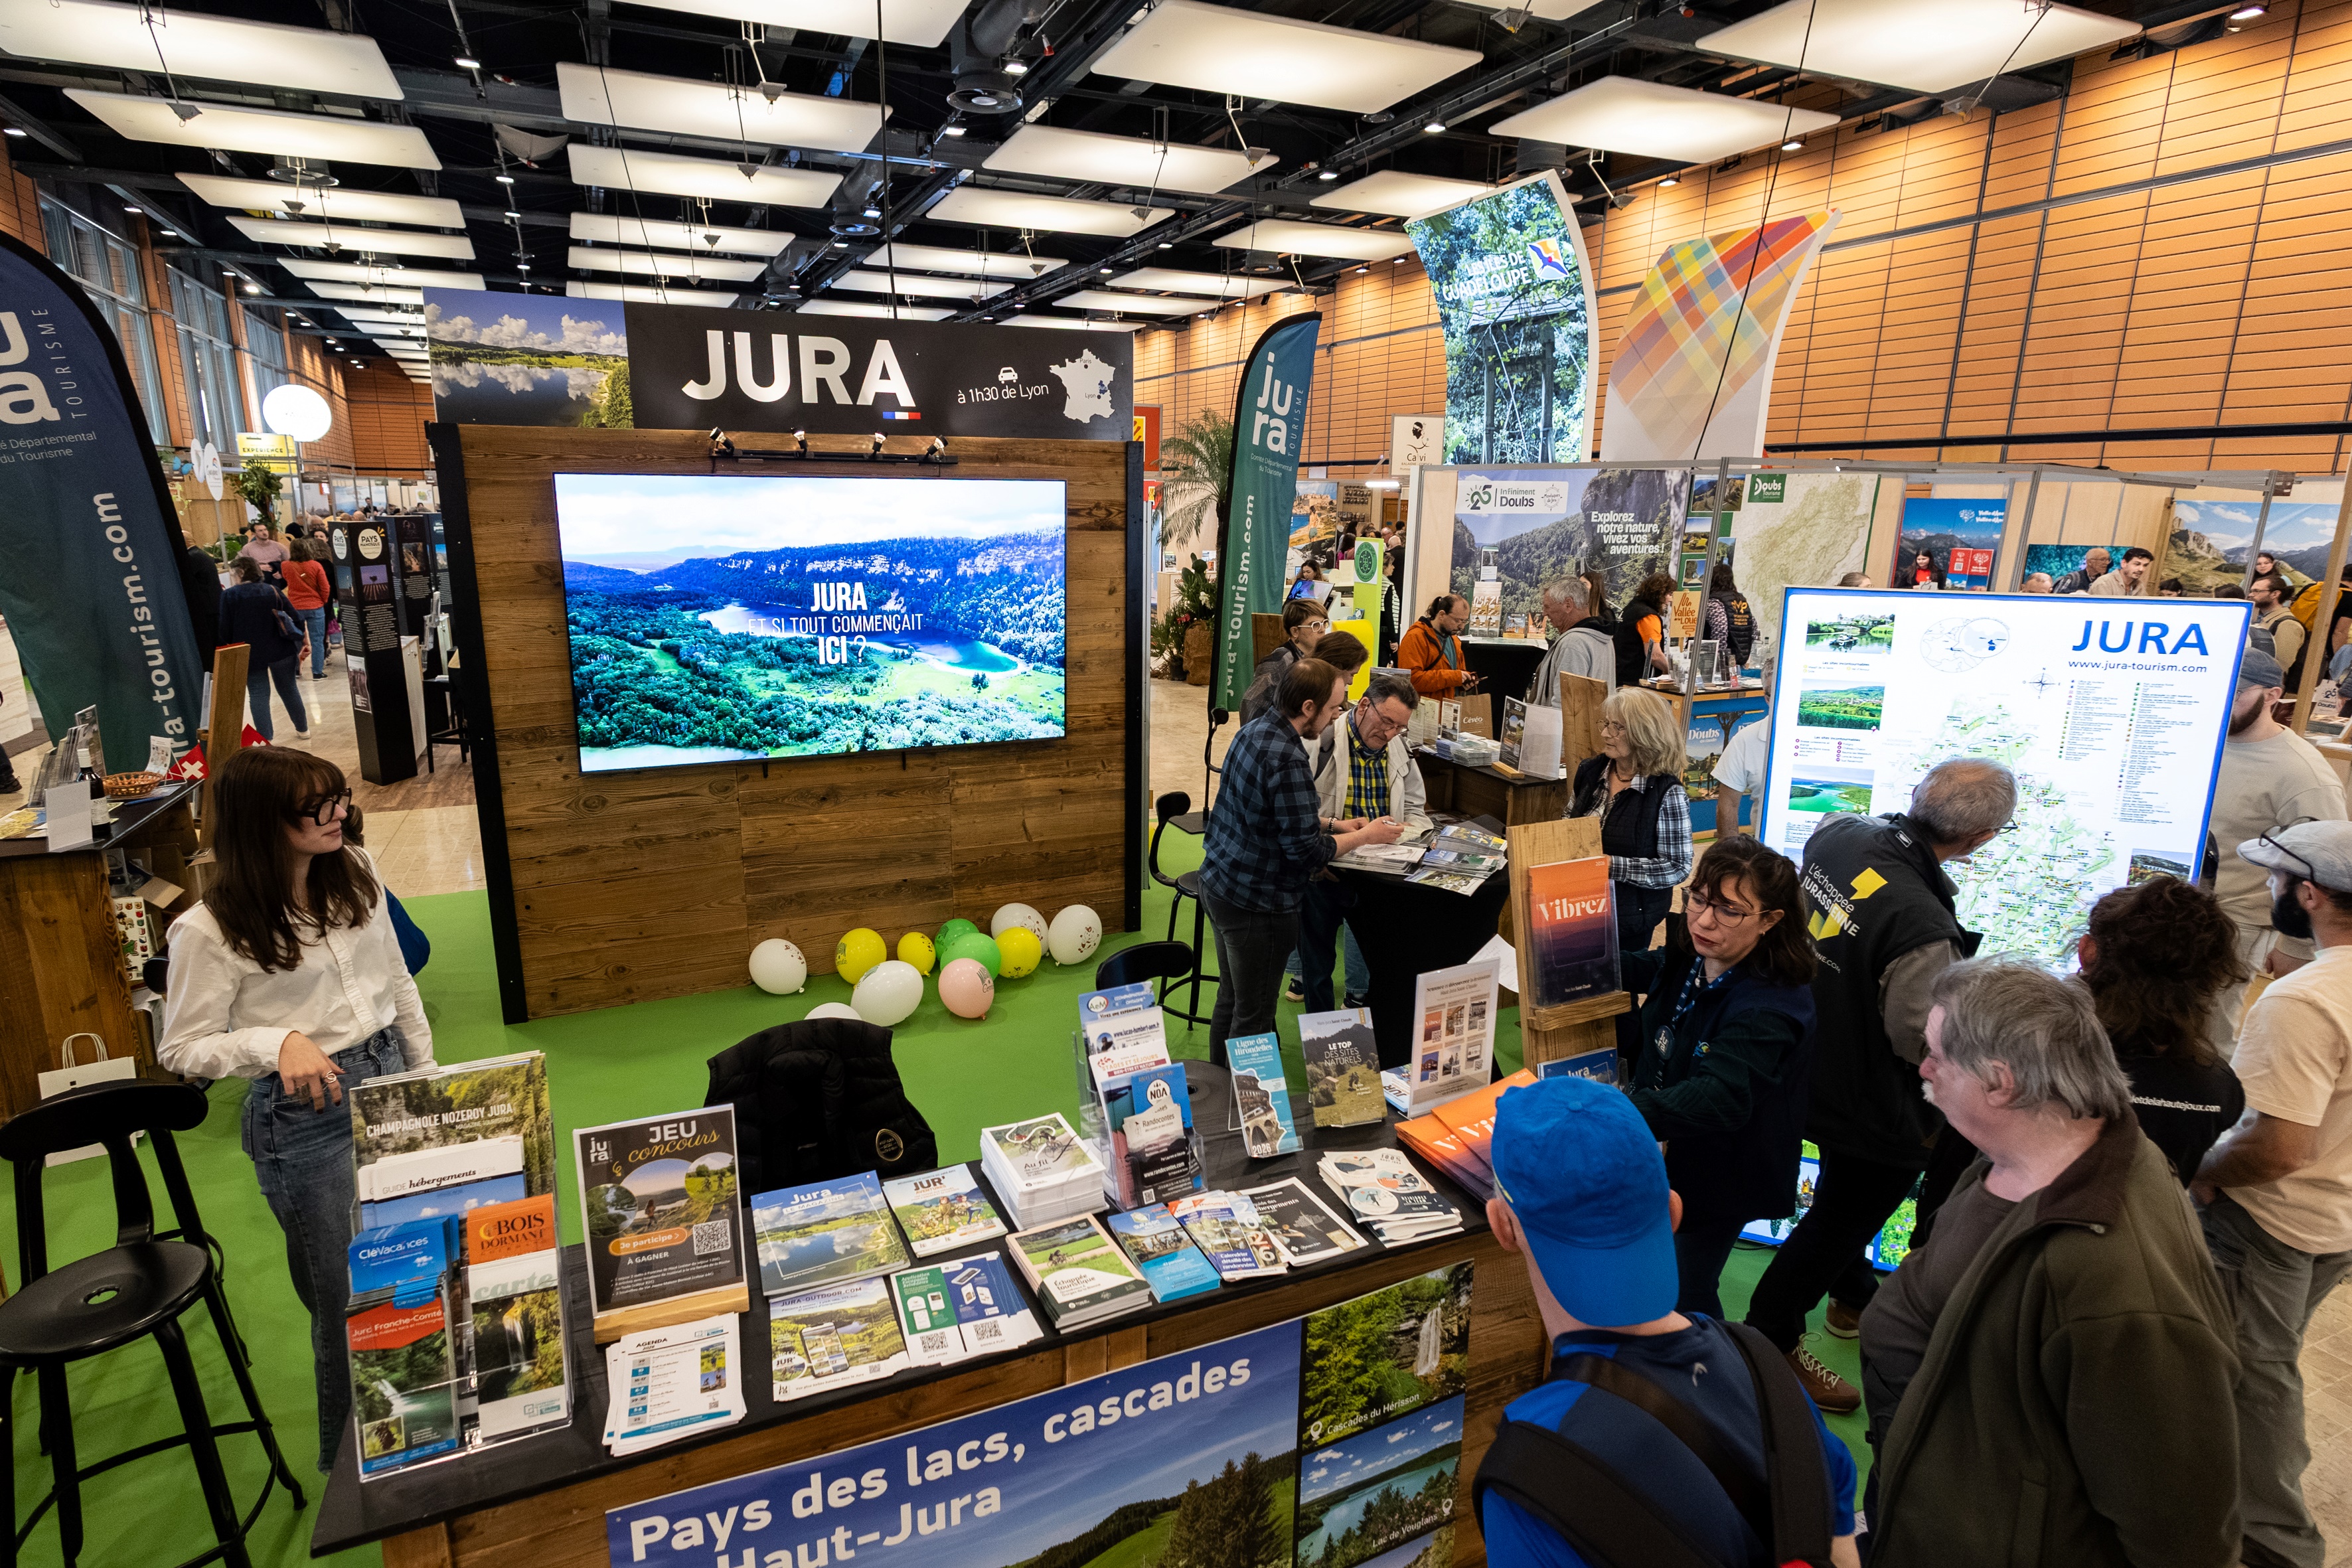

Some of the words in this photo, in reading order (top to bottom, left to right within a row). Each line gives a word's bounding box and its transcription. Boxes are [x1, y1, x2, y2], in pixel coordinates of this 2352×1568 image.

[1465, 261, 1486, 276] LES
[1508, 250, 1526, 266] DE
[1442, 266, 1532, 301] GUADELOUPE
[32, 309, 87, 419] TOURISME
[682, 330, 916, 407] JURA
[1257, 351, 1293, 416] ju
[957, 390, 966, 404] à
[969, 386, 998, 402] 1h30
[1002, 385, 1016, 399] de
[1020, 384, 1050, 400] Lyon
[1287, 388, 1304, 457] TOURISME
[9, 431, 97, 449] Départemental
[1252, 410, 1287, 455] ra
[1, 453, 15, 463] du
[17, 447, 73, 461] Tourisme
[1251, 453, 1265, 463] Comité
[1265, 456, 1293, 472] Départemental
[1265, 467, 1282, 477] Tourisme
[1500, 496, 1535, 507] Doubs
[1591, 510, 1635, 523] Explorez
[1597, 522, 1624, 532] notre
[1626, 522, 1660, 534] nature,
[1603, 534, 1628, 544] vivez
[1630, 534, 1648, 543] vos
[811, 582, 868, 612] JURA
[1674, 606, 1695, 617] Vallée
[748, 618, 766, 636] ET
[772, 617, 785, 634] SI
[790, 616, 827, 634] TOUT
[832, 613, 923, 635] COMMENÇAIT
[2072, 620, 2209, 656] JURA
[818, 635, 847, 665] ICI
[854, 635, 867, 663] ?
[2069, 661, 2207, 672] www.jura-tourism.com
[1462, 716, 1484, 724] Cévéo
[1688, 728, 1720, 740] Doubs
[1535, 898, 1608, 921] Vibrez
[1800, 876, 1860, 937] JURASSIENNE
[1234, 1045, 1273, 1056] Hirondelles
[1236, 1039, 1255, 1048] Ligne
[1328, 1042, 1336, 1051] LE
[1324, 1050, 1339, 1059] DES
[1340, 1047, 1360, 1057] SITES
[1324, 1054, 1362, 1067] NATURELS
[1102, 1061, 1125, 1071] STAGES
[1133, 1054, 1159, 1063] SÉJOURS
[1514, 1071, 1528, 1081] 2026
[1150, 1089, 1168, 1101] NOA
[366, 1113, 440, 1138] CHAMPAGNOLE
[441, 1107, 485, 1125] NOZEROY
[487, 1102, 513, 1117] JURA
[455, 1121, 482, 1130] MAGAZINE
[483, 1115, 515, 1126] TOURISTIQUE
[1142, 1115, 1175, 1128] Randocontes
[649, 1120, 697, 1144] JEU
[589, 1137, 608, 1154] ju
[628, 1129, 720, 1163] concours
[1252, 1142, 1272, 1155] 2026
[590, 1151, 609, 1163] ra
[1038, 1159, 1049, 1168] fil
[1381, 1153, 1401, 1162] 100%
[1143, 1161, 1185, 1178] www.randocontes.com
[382, 1182, 408, 1194] GUIDE
[408, 1169, 477, 1189] hébergements
[913, 1176, 945, 1191] JUR'
[915, 1184, 947, 1194] AVENTURES
[790, 1188, 832, 1206] Jura
[798, 1194, 844, 1209] MAGAZINE
[498, 1212, 545, 1235] BOIS
[481, 1229, 544, 1251] DORMANT
[633, 1233, 673, 1249] participe
[627, 1257, 634, 1265] À
[635, 1251, 670, 1264] GAGNER
[1222, 1261, 1256, 1269] randonnées
[901, 1272, 930, 1281] Application
[1054, 1273, 1087, 1287] Échappée
[1056, 1277, 1095, 1291] touristique
[473, 1272, 554, 1301] carte
[780, 1287, 862, 1307] JURA-OUTDOOR.COM
[374, 1309, 443, 1331] Franche-Comté
[636, 1338, 668, 1348] AGENDA
[1327, 1413, 1369, 1435] Cascades
[1370, 1409, 1381, 1418] du
[1383, 1393, 1420, 1413] Hérisson
[630, 1499, 773, 1561] Pays
[791, 1468, 888, 1519] des
[907, 1431, 1026, 1486] lacs,
[1044, 1358, 1251, 1444] cascades
[714, 1486, 1002, 1568] Haut-Jura
[1373, 1537, 1388, 1548] Lac
[1389, 1531, 1400, 1539] de
[1401, 1513, 1439, 1535] Vouglans
